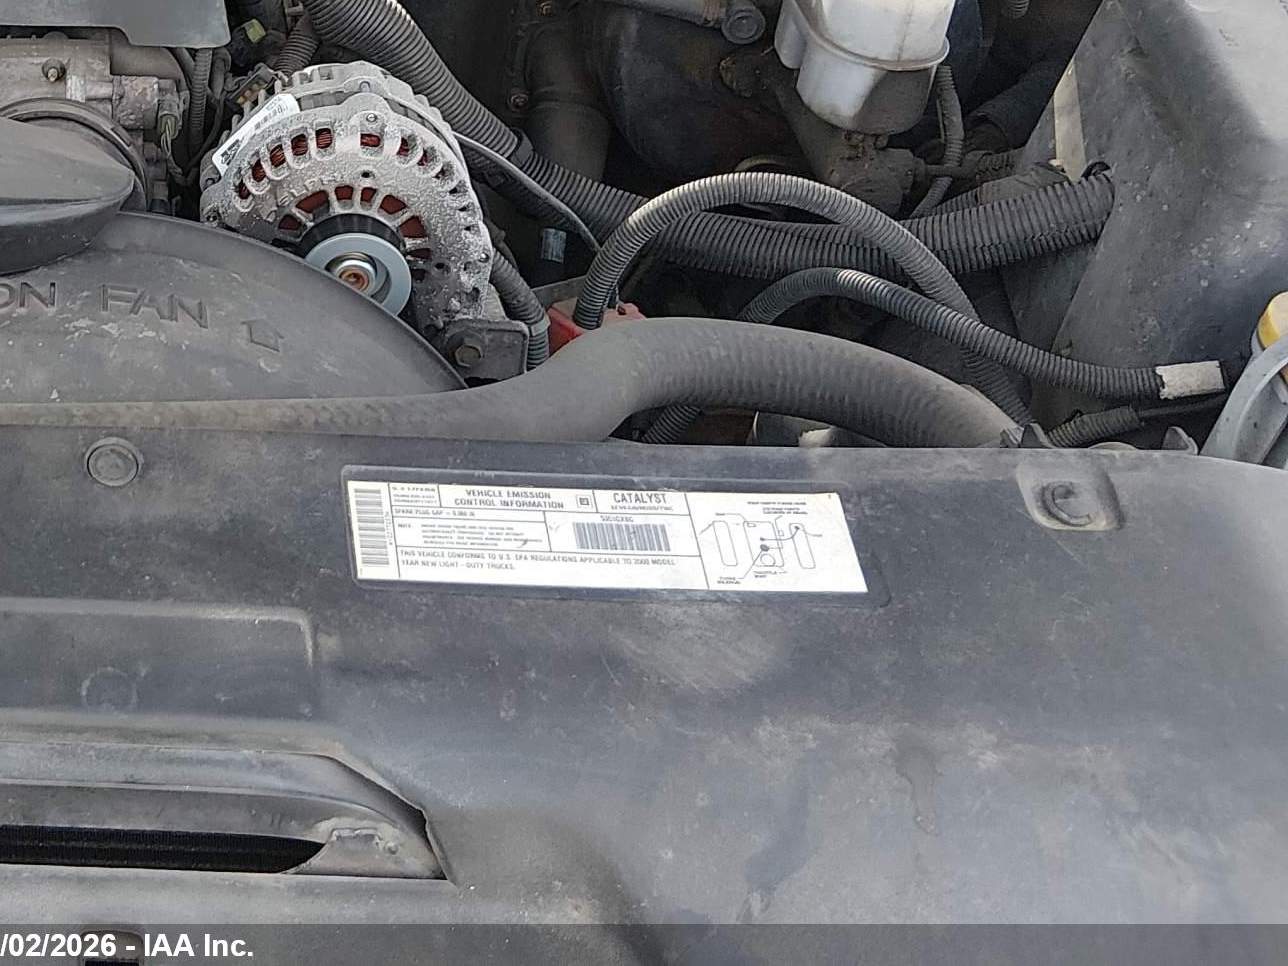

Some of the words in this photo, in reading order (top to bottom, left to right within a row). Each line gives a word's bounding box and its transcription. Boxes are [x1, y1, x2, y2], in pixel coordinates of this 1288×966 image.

[101, 282, 210, 330] FAN
[465, 489, 503, 498] VEHICLE
[507, 490, 551, 499] EMISSION
[613, 492, 667, 504] CATALYST
[454, 498, 497, 507] CONTROL
[499, 499, 563, 509] INFORMATION
[400, 549, 416, 557] THIS
[418, 550, 445, 558] VEHICLE
[447, 551, 485, 560] CONFORMS
[488, 552, 497, 560] TO
[515, 553, 528, 561] EPA
[530, 554, 578, 563] REGULATIONS
[580, 556, 620, 564] APPLICABLE
[623, 557, 632, 565] TO
[651, 558, 675, 566] MODEL
[401, 559, 419, 567] YEAR
[439, 560, 458, 568] LIGHT
[466, 561, 484, 569] DUTY
